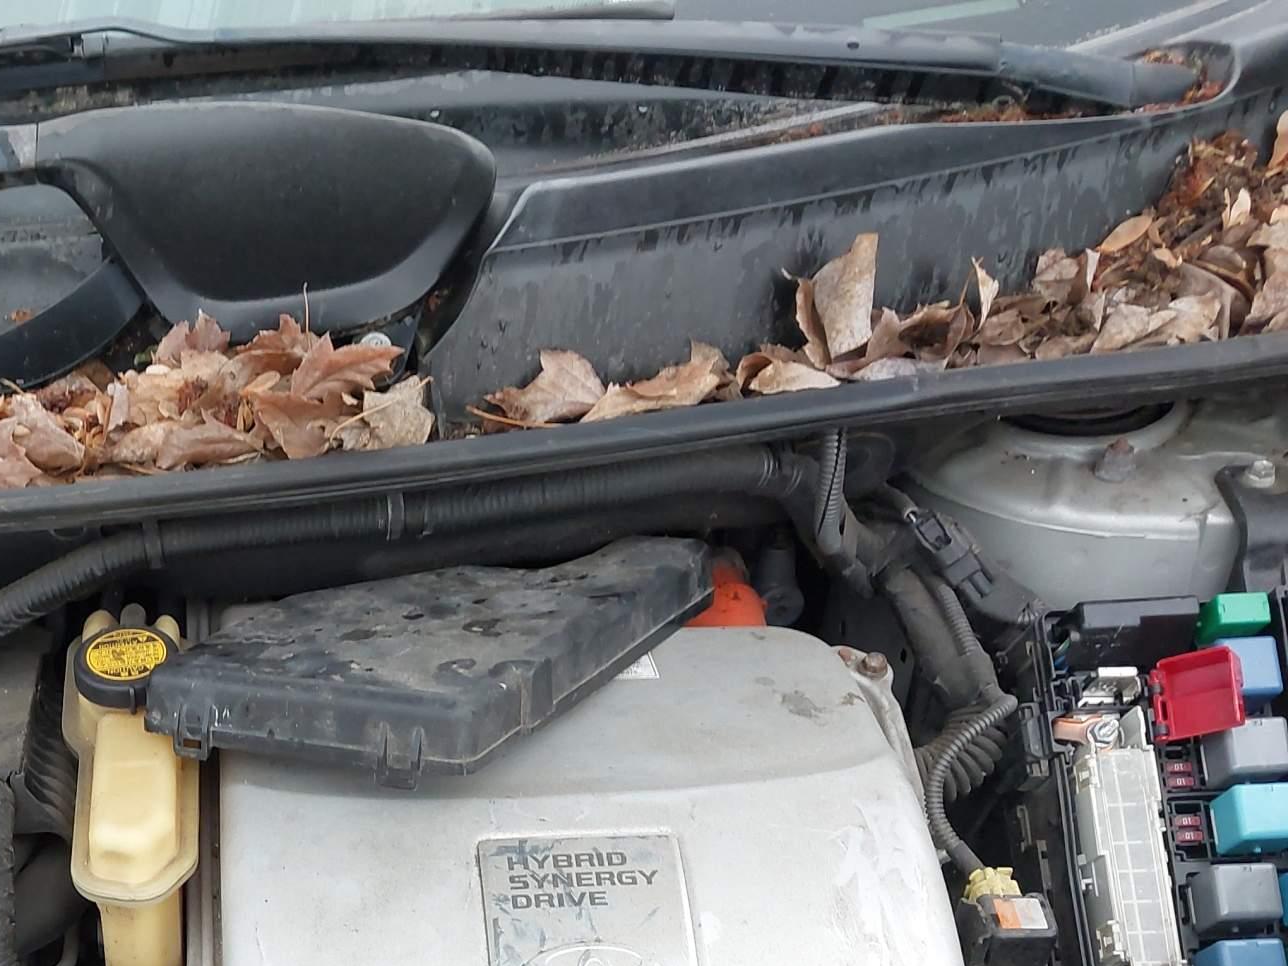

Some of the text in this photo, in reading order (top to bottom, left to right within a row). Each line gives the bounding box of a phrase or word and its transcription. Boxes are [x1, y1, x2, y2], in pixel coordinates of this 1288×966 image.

[1174, 763, 1184, 771] 10
[1176, 777, 1186, 786] 10
[1182, 817, 1192, 826] 10
[1185, 832, 1194, 840] 10
[507, 851, 627, 871] HYBRID
[509, 869, 659, 890] SYNERGY
[512, 890, 609, 909] DRIVE
